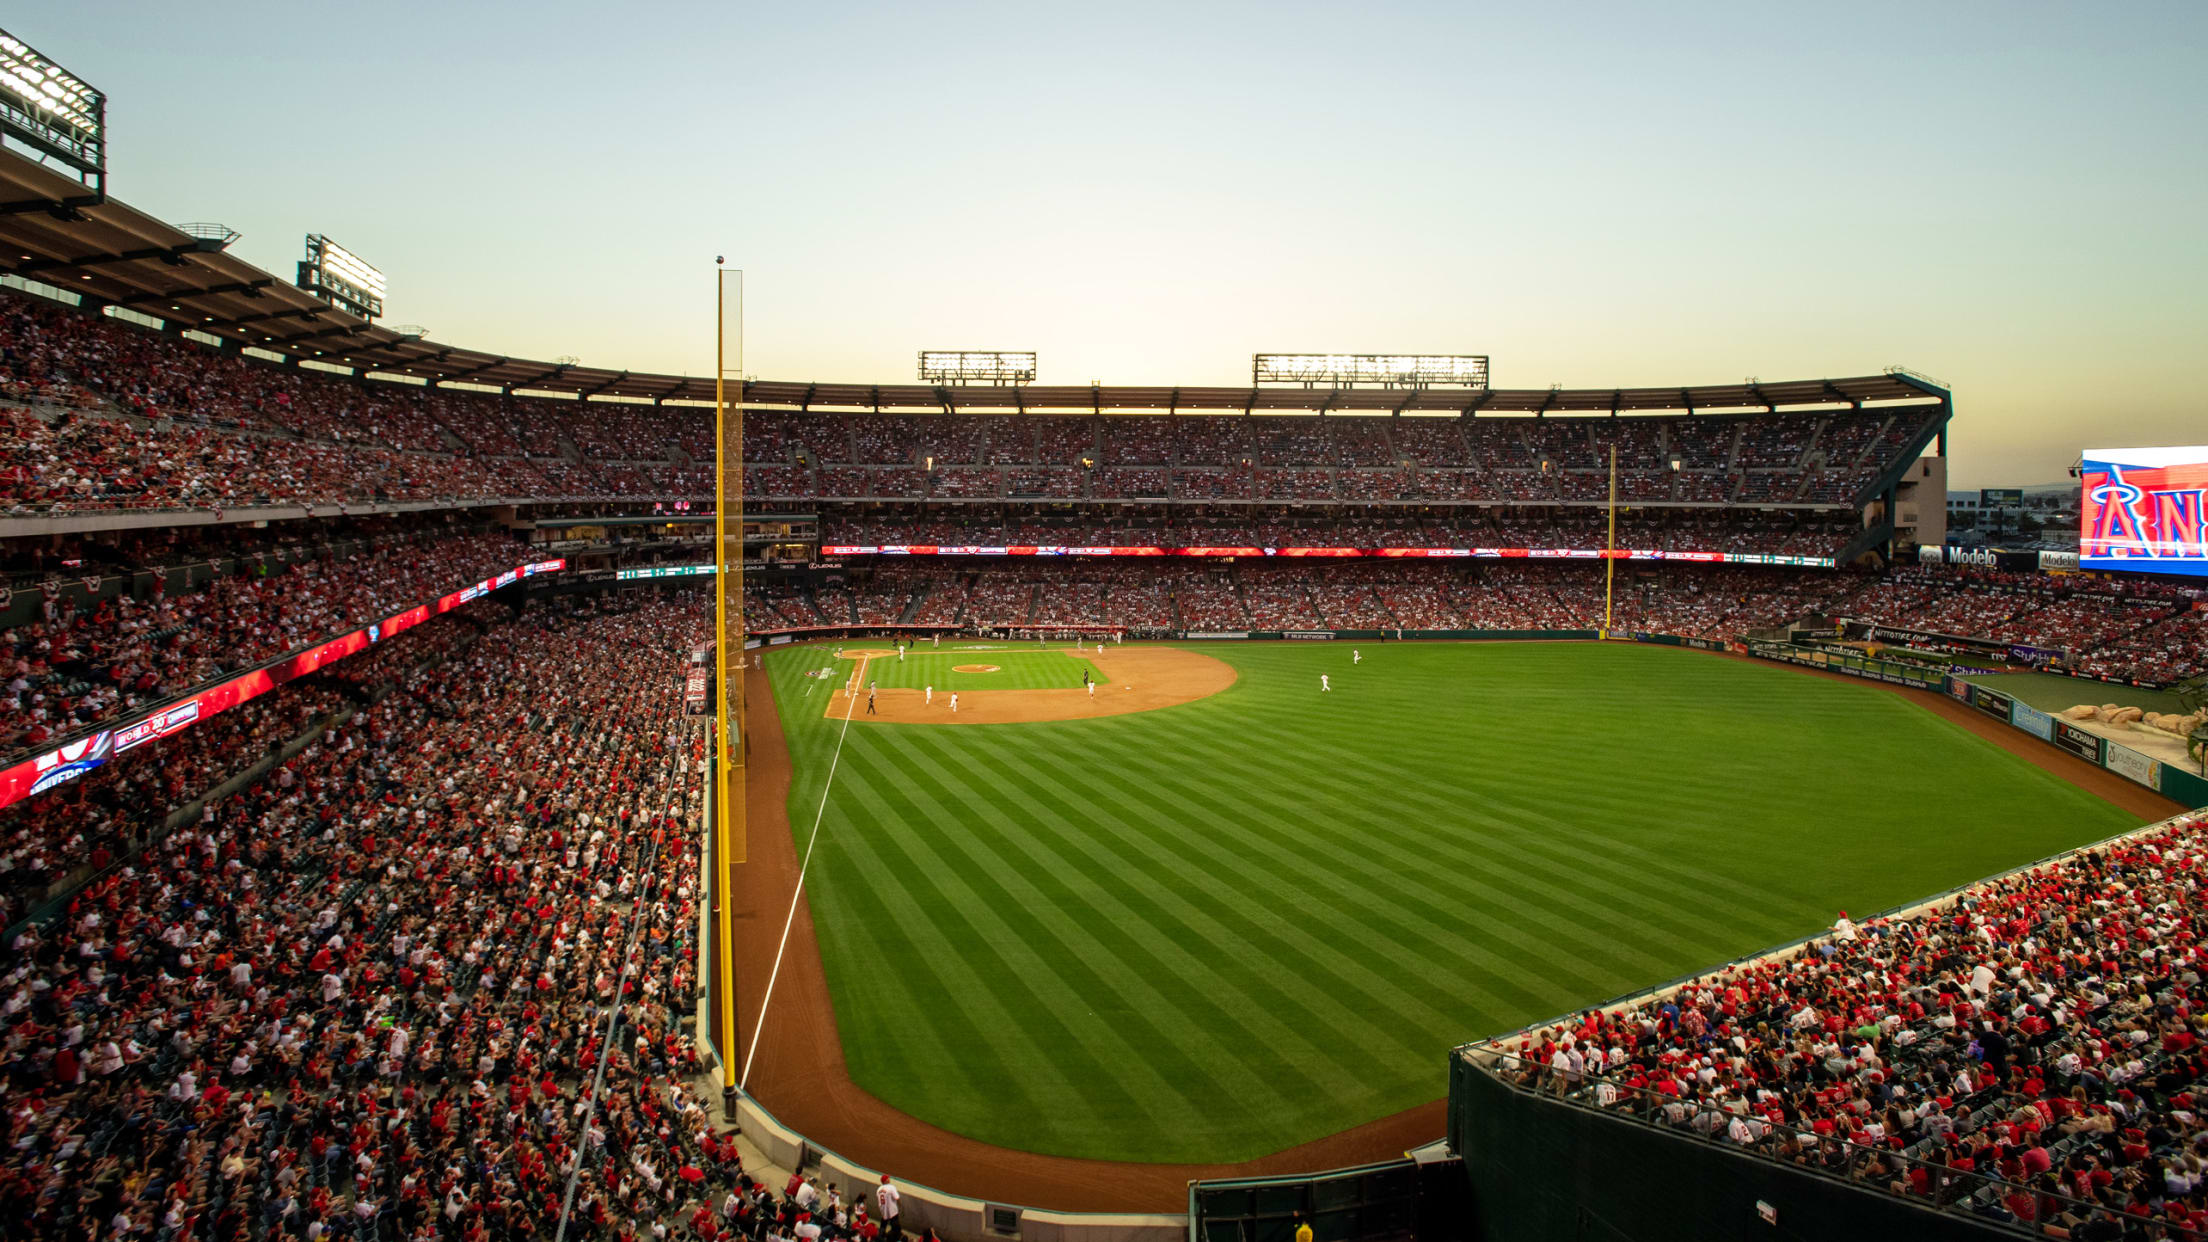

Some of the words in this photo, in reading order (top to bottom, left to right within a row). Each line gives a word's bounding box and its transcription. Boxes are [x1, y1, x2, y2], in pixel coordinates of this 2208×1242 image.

[1949, 546, 1997, 565] Modelo
[2044, 553, 2077, 566] Modelo
[2081, 745, 2097, 760] TIRES
